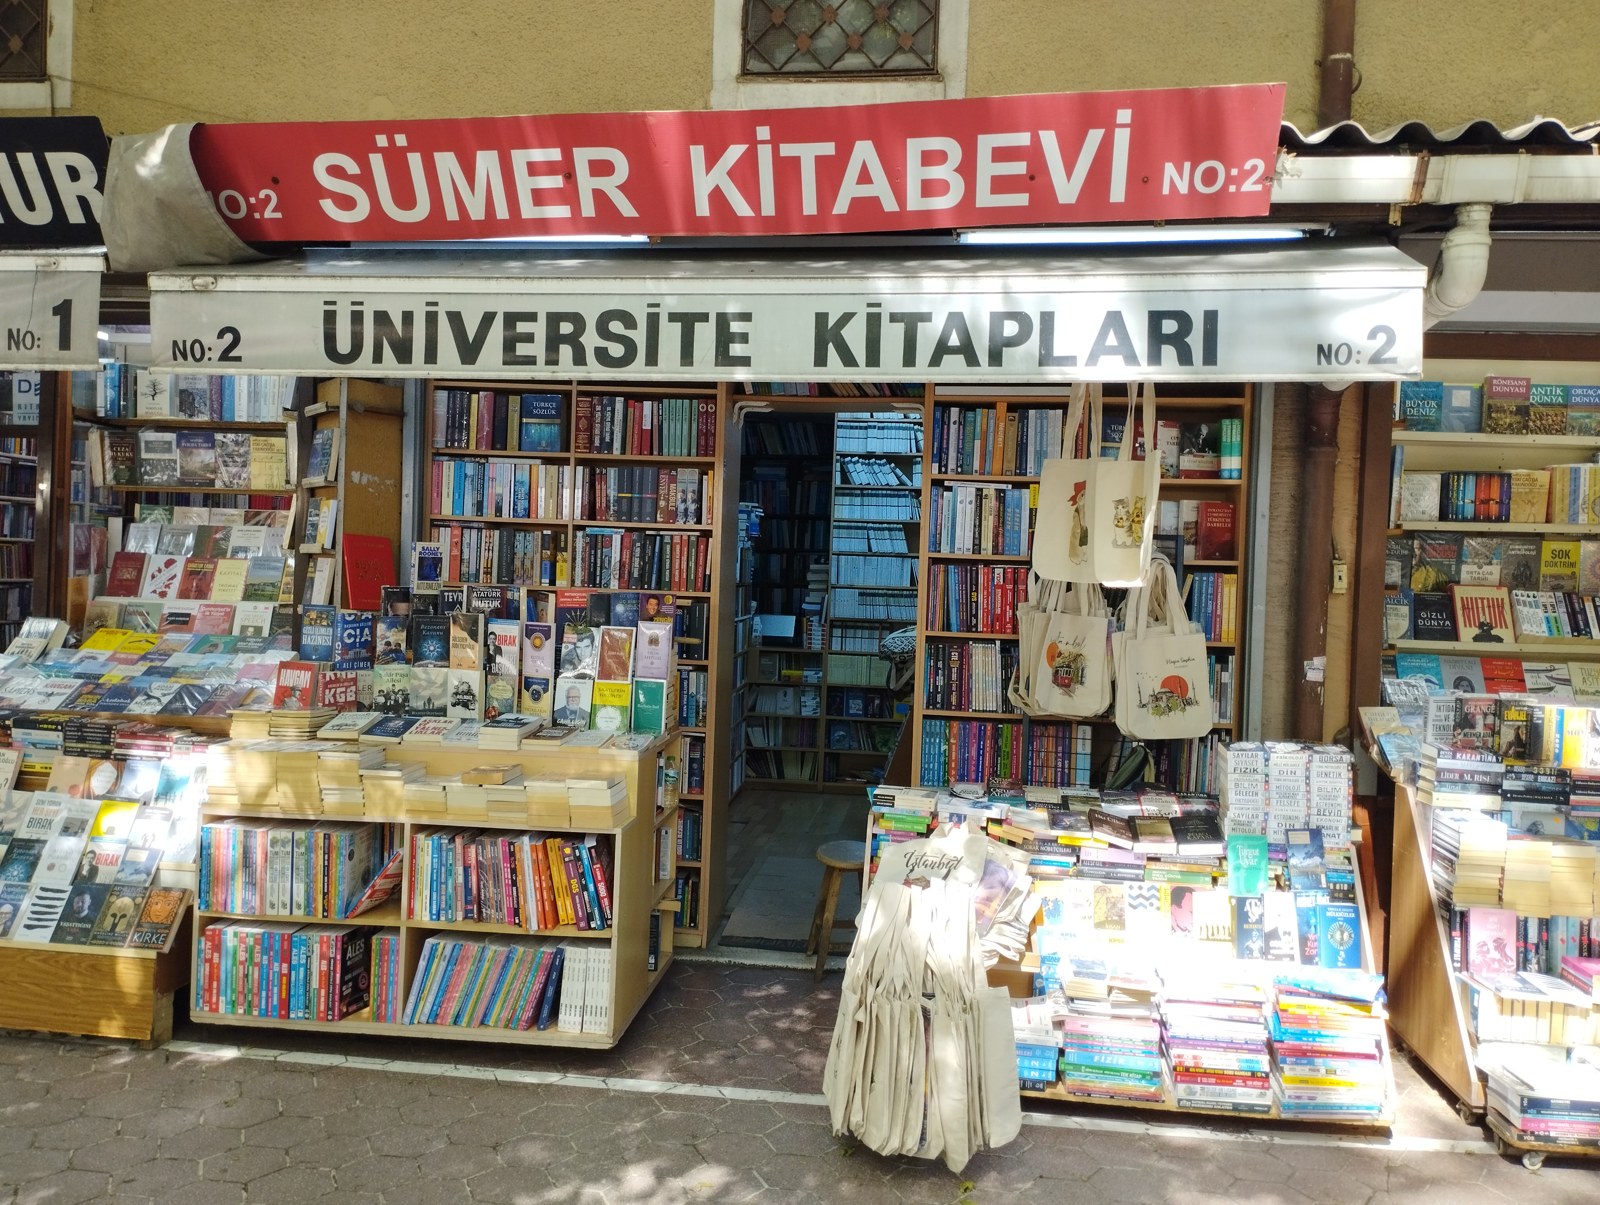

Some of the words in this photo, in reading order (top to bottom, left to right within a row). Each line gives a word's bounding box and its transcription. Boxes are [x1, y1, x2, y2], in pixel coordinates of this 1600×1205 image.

[312, 133, 640, 223] SÜMER
[690, 108, 1132, 217] KİTABEVİ
[1162, 158, 1266, 196] NO:2
[0, 151, 104, 226] UR
[7, 328, 42, 352] NO:
[52, 298, 73, 352] 1
[322, 300, 754, 370] ÜNİVERSİTE
[813, 302, 1220, 368] KİTAPLARI
[171, 340, 213, 363] NO:
[217, 326, 243, 363] 2
[1316, 343, 1362, 366] NO:
[1366, 325, 1398, 366] 2
[1492, 378, 1527, 386] RÖNESANS
[1492, 385, 1526, 393] DÜNYASI
[1530, 385, 1564, 395] ANTİK
[1405, 399, 1438, 408] BÜYÜK
[1406, 407, 1437, 416] DENİZ
[668, 483, 677, 511] MAKBULE
[1550, 549, 1571, 560] ŞOK
[472, 600, 501, 608] NUTUK
[1420, 611, 1447, 619] GİZLİ
[1460, 596, 1509, 629] NUTUK
[1418, 619, 1452, 627] DÜNYA
[496, 634, 517, 647] BIRAK
[279, 668, 312, 689] KAVGAM
[324, 685, 356, 705] KGB
[1464, 703, 1496, 714] GRANGÉ
[26, 817, 55, 830] BIRAK
[95, 852, 122, 866] BIRAK
[570, 878, 580, 894] DGS
[345, 938, 365, 960] ALES
